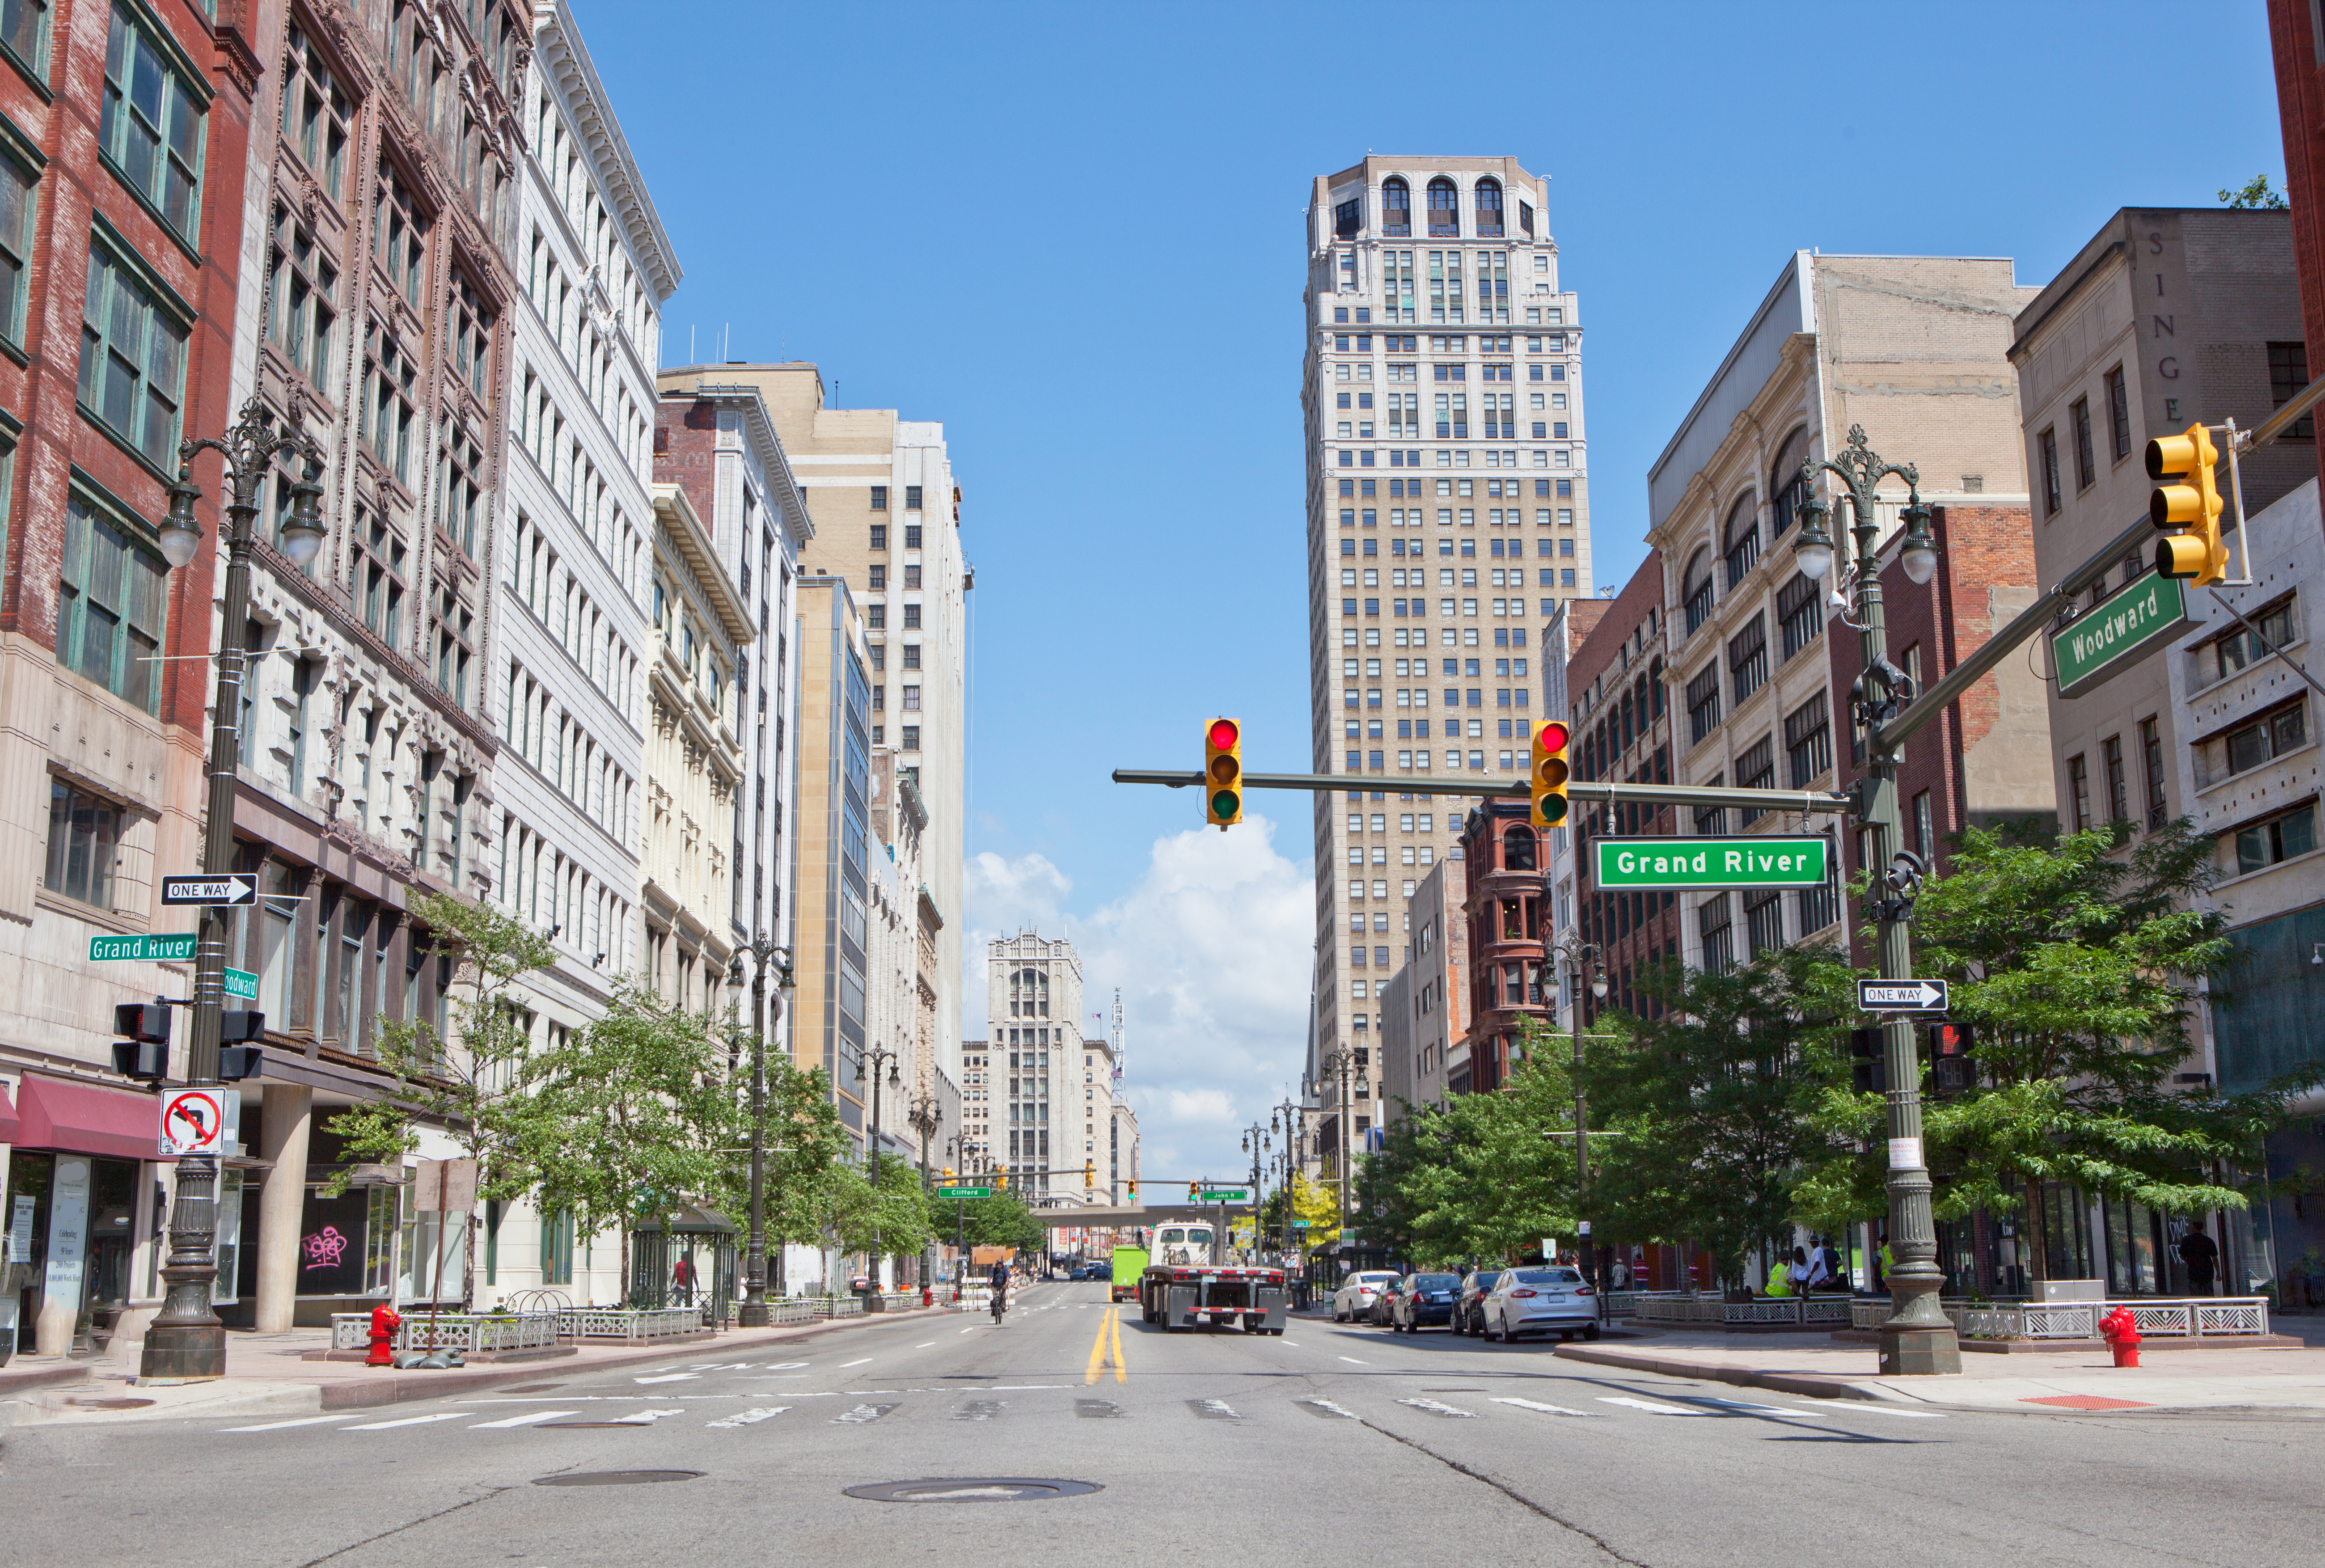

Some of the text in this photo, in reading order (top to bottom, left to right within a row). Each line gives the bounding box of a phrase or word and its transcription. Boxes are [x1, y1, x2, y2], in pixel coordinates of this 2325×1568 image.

[2072, 587, 2158, 664] Woodward
[1617, 850, 1808, 874] Grand River
[171, 883, 231, 896] ONE WAY
[93, 938, 193, 959] Grand River
[1868, 989, 1923, 1001] ONE WAY
[59, 1229, 78, 1240] Celebrating:
[60, 1247, 73, 1255] 50 Years
[63, 1260, 76, 1270] Projects
[63, 1274, 72, 1282] Work
[72, 1274, 81, 1282] Hours
